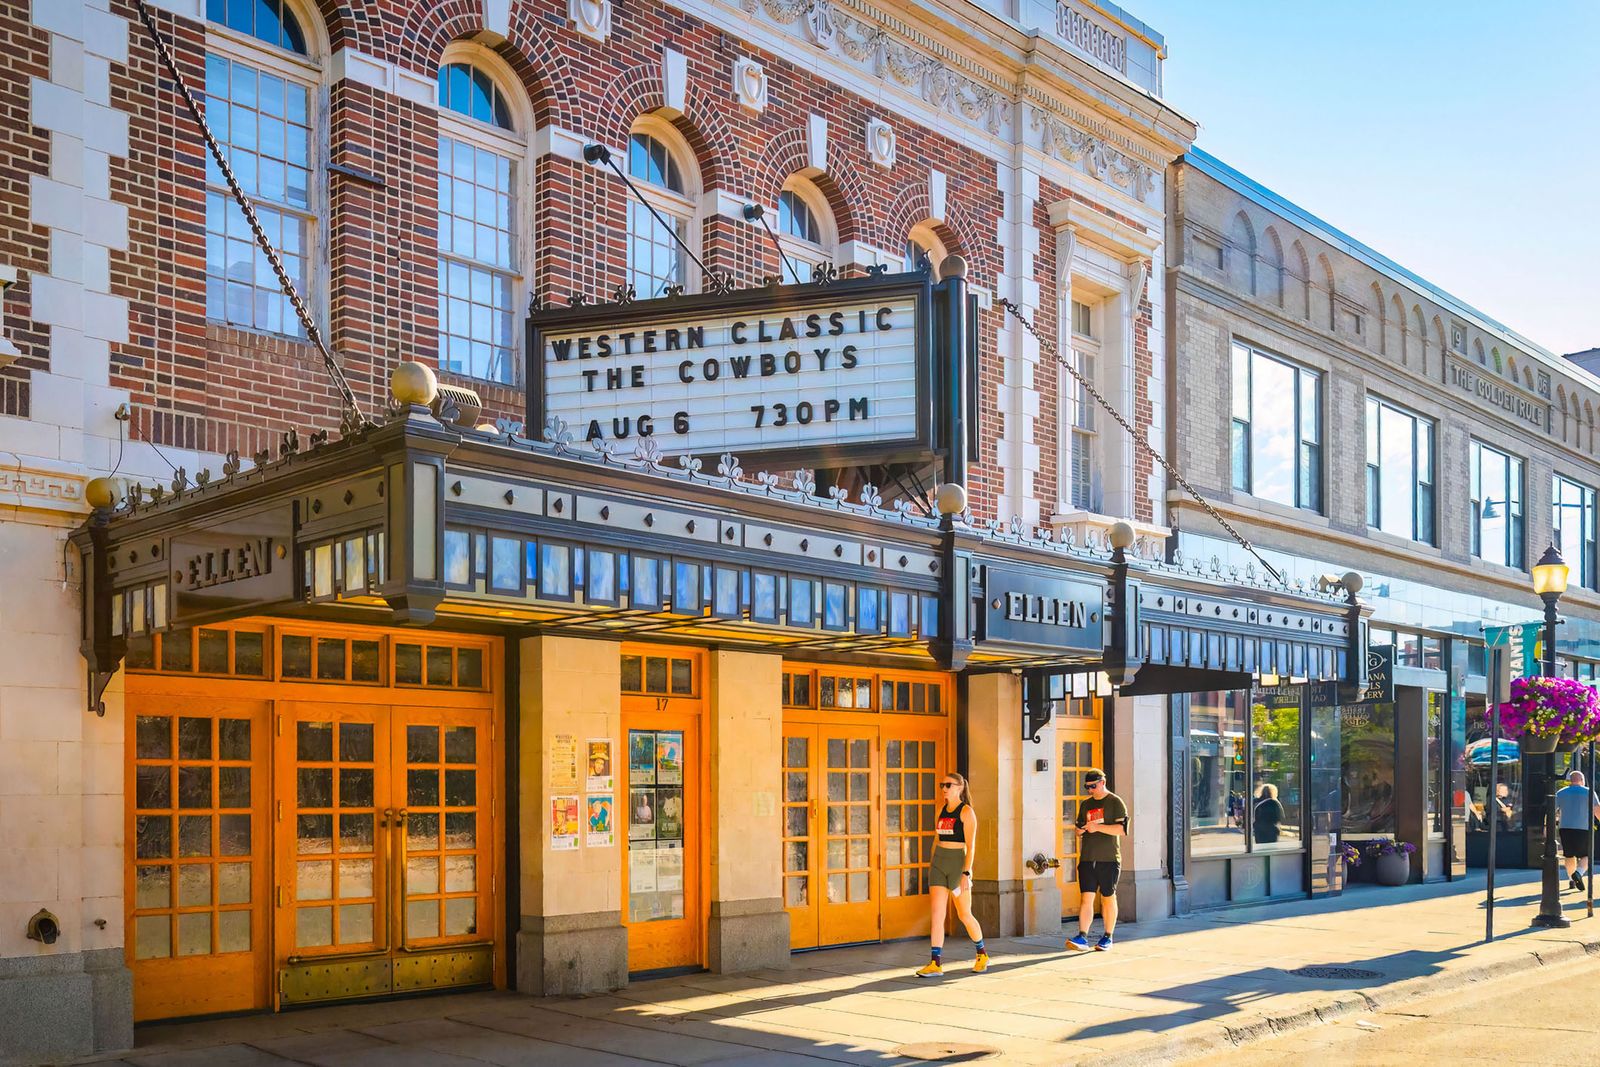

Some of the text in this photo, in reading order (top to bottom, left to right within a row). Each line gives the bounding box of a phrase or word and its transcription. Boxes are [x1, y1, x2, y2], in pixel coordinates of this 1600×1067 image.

[551, 307, 893, 361] WESTERN CLASSIC
[1451, 327, 1461, 347] 19
[582, 345, 858, 392] THE COWBOYS
[1452, 365, 1542, 426] THE GOLDEN RULE
[586, 397, 868, 442] AUG 6 730PM
[185, 537, 273, 591] ELLEN
[1005, 591, 1087, 628] ELLEN
[1368, 672, 1386, 681] ANA
[656, 697, 669, 711] 17
